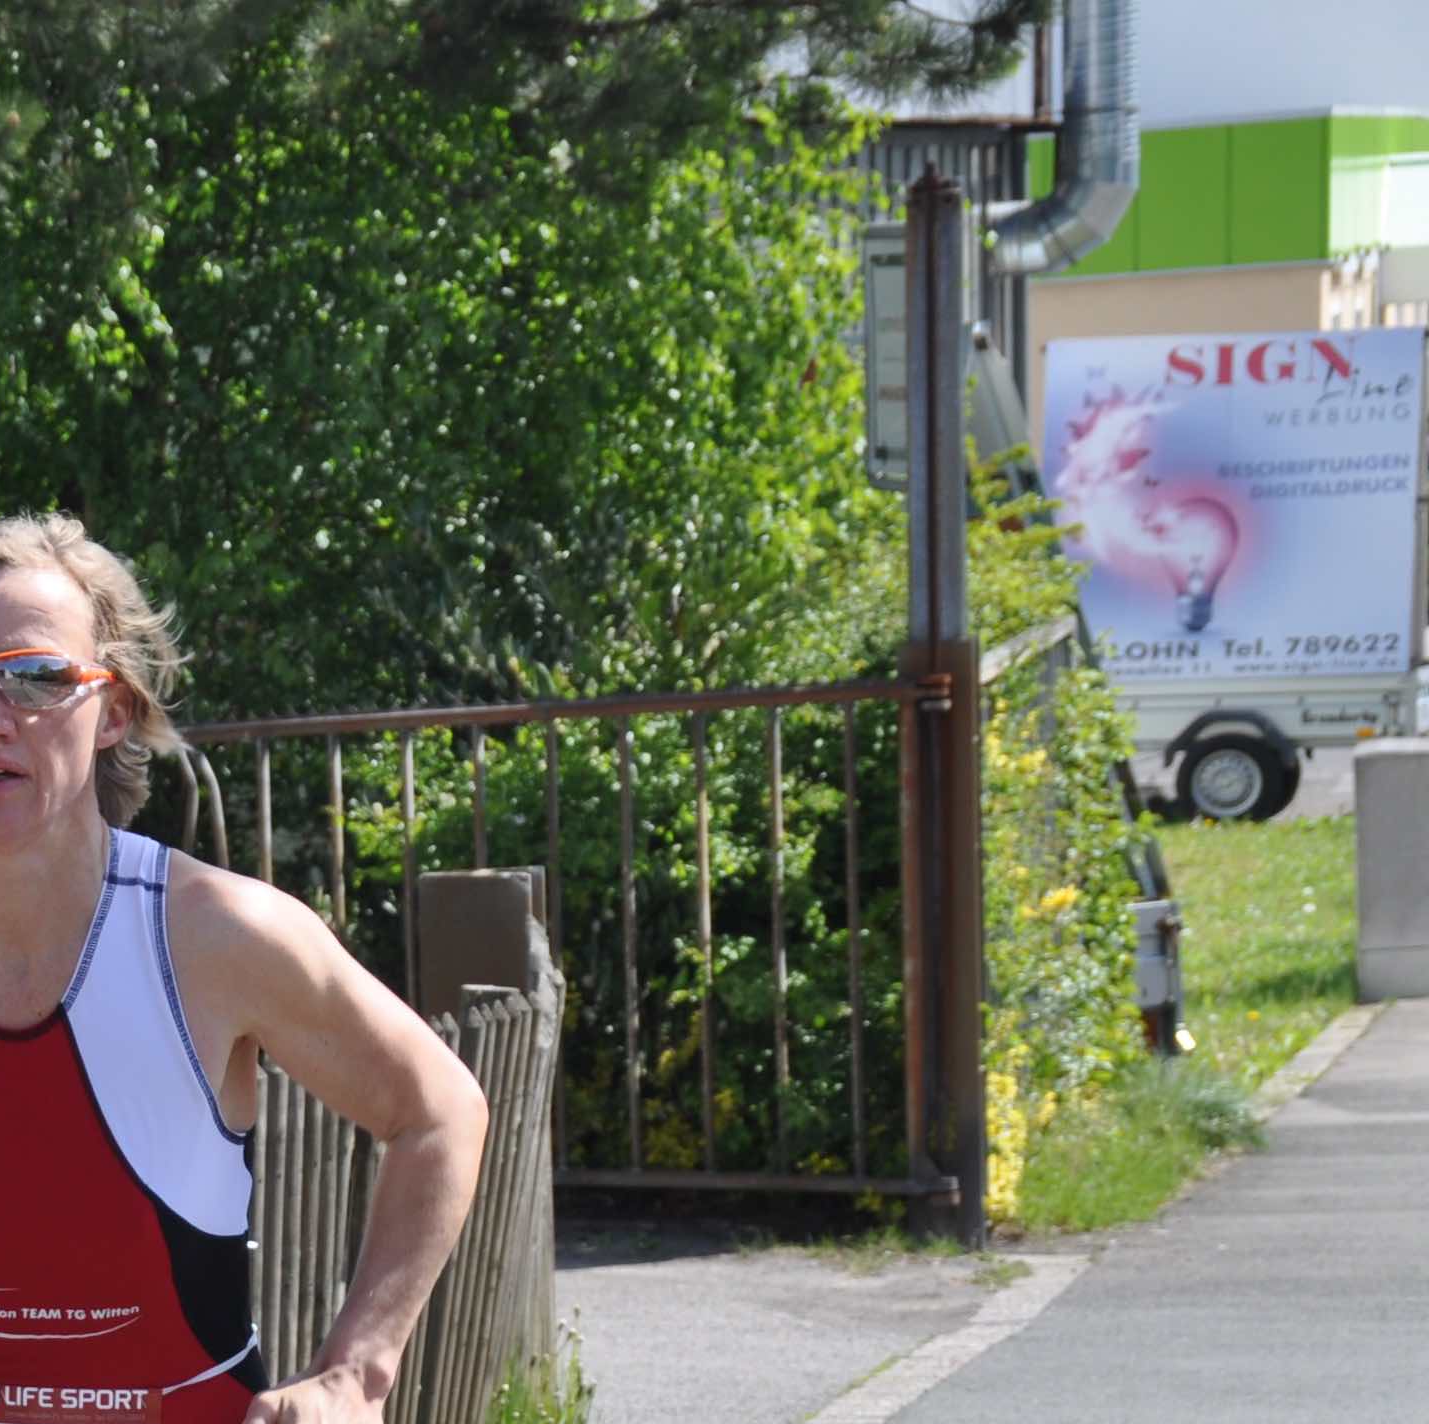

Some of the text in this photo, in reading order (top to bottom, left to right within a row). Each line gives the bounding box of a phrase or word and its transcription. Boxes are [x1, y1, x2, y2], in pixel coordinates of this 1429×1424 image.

[1163, 337, 1359, 386] SIGN
[1317, 362, 1413, 403] Line
[1263, 401, 1412, 427] WERBUNG
[1217, 453, 1410, 480] BESCHRIFTUNGEN
[1249, 476, 1410, 500] DIGITALDRUCK
[1222, 636, 1271, 658] Tel.
[1285, 632, 1401, 656] 789622
[21, 1308, 62, 1320] TEAM
[66, 1309, 86, 1320] TG
[90, 1305, 140, 1320] Witten
[4, 1385, 149, 1410] LIFE SPORT
